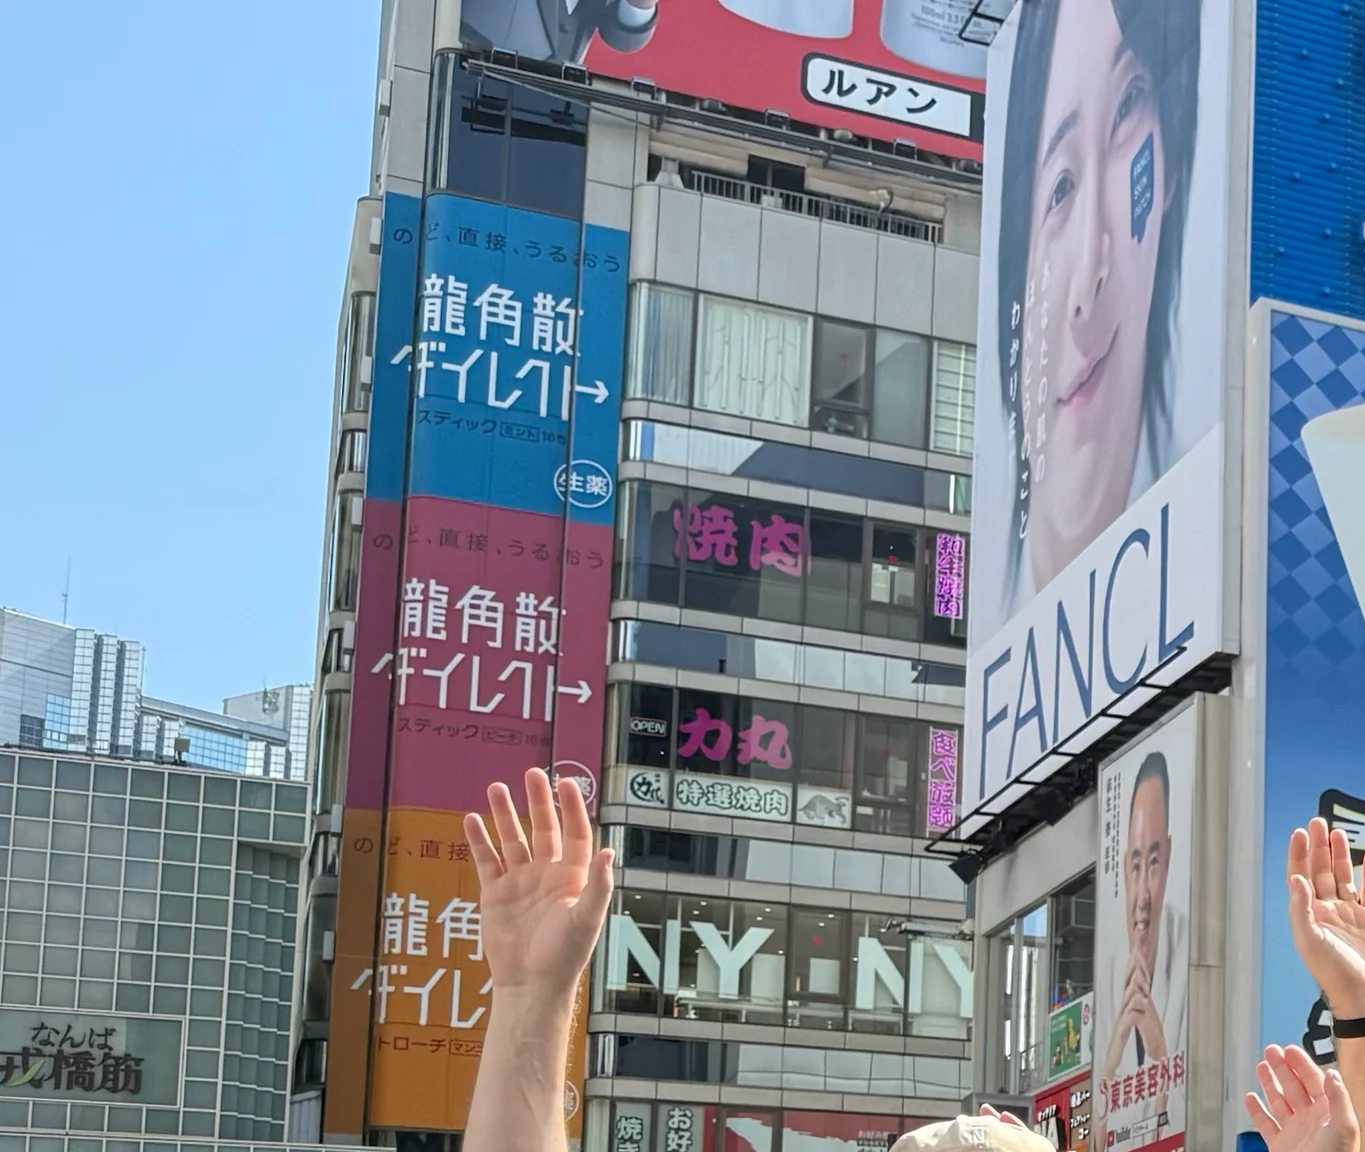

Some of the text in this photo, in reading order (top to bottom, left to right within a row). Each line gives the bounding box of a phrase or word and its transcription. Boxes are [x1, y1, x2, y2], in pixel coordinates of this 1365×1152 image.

[820, 68, 938, 117] ルアン
[392, 222, 621, 274] のど、直接、うるおう
[421, 272, 585, 357] 龍角散
[390, 340, 610, 422] ダイレクト
[418, 409, 498, 434] スティック
[673, 503, 811, 577] 焼肉
[403, 577, 567, 657] 龍角散
[979, 503, 1195, 801] FANCL
[370, 647, 592, 722] ダイレクト
[398, 717, 480, 740] スティック
[631, 718, 665, 734] OPEN
[677, 707, 792, 770] 力丸
[676, 778, 789, 816] 特選焼肉
[383, 892, 484, 961] 龍角
[607, 914, 775, 999] NY
[31, 1021, 115, 1052] なんば
[377, 1036, 448, 1053] トローチ
[1110, 1050, 1185, 1113] 東京美容外科
